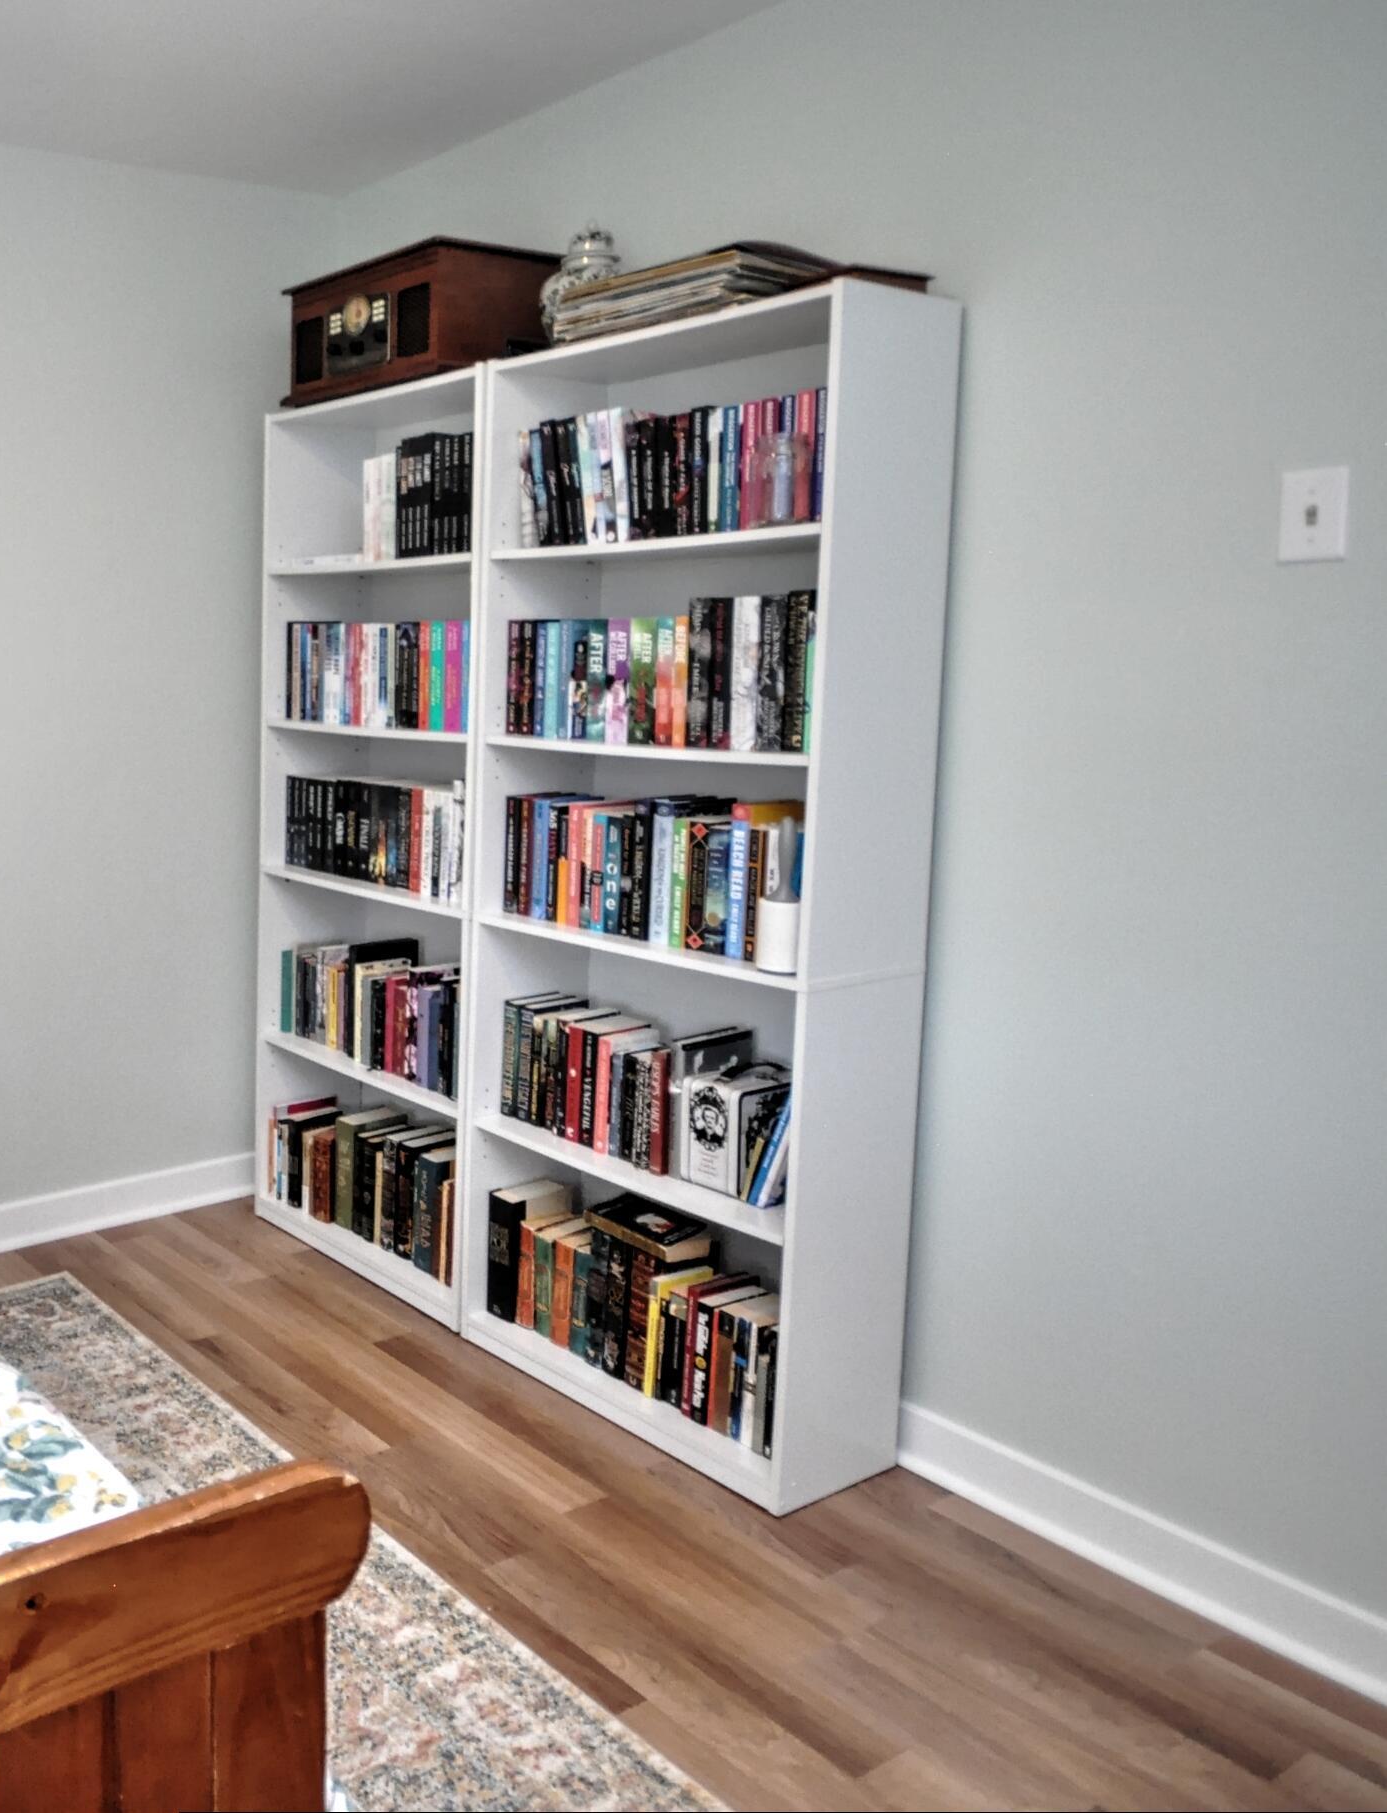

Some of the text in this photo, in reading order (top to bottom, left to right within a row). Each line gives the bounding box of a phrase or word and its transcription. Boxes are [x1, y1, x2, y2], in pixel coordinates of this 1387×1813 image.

[589, 632, 604, 673] AFTER
[616, 631, 627, 661] AFTER
[641, 633, 653, 664] AFTER
[675, 625, 687, 664] BEFORE
[549, 809, 558, 829] 365
[730, 830, 746, 900] BEACH READ
[583, 1077, 593, 1130] VENGEFUL
